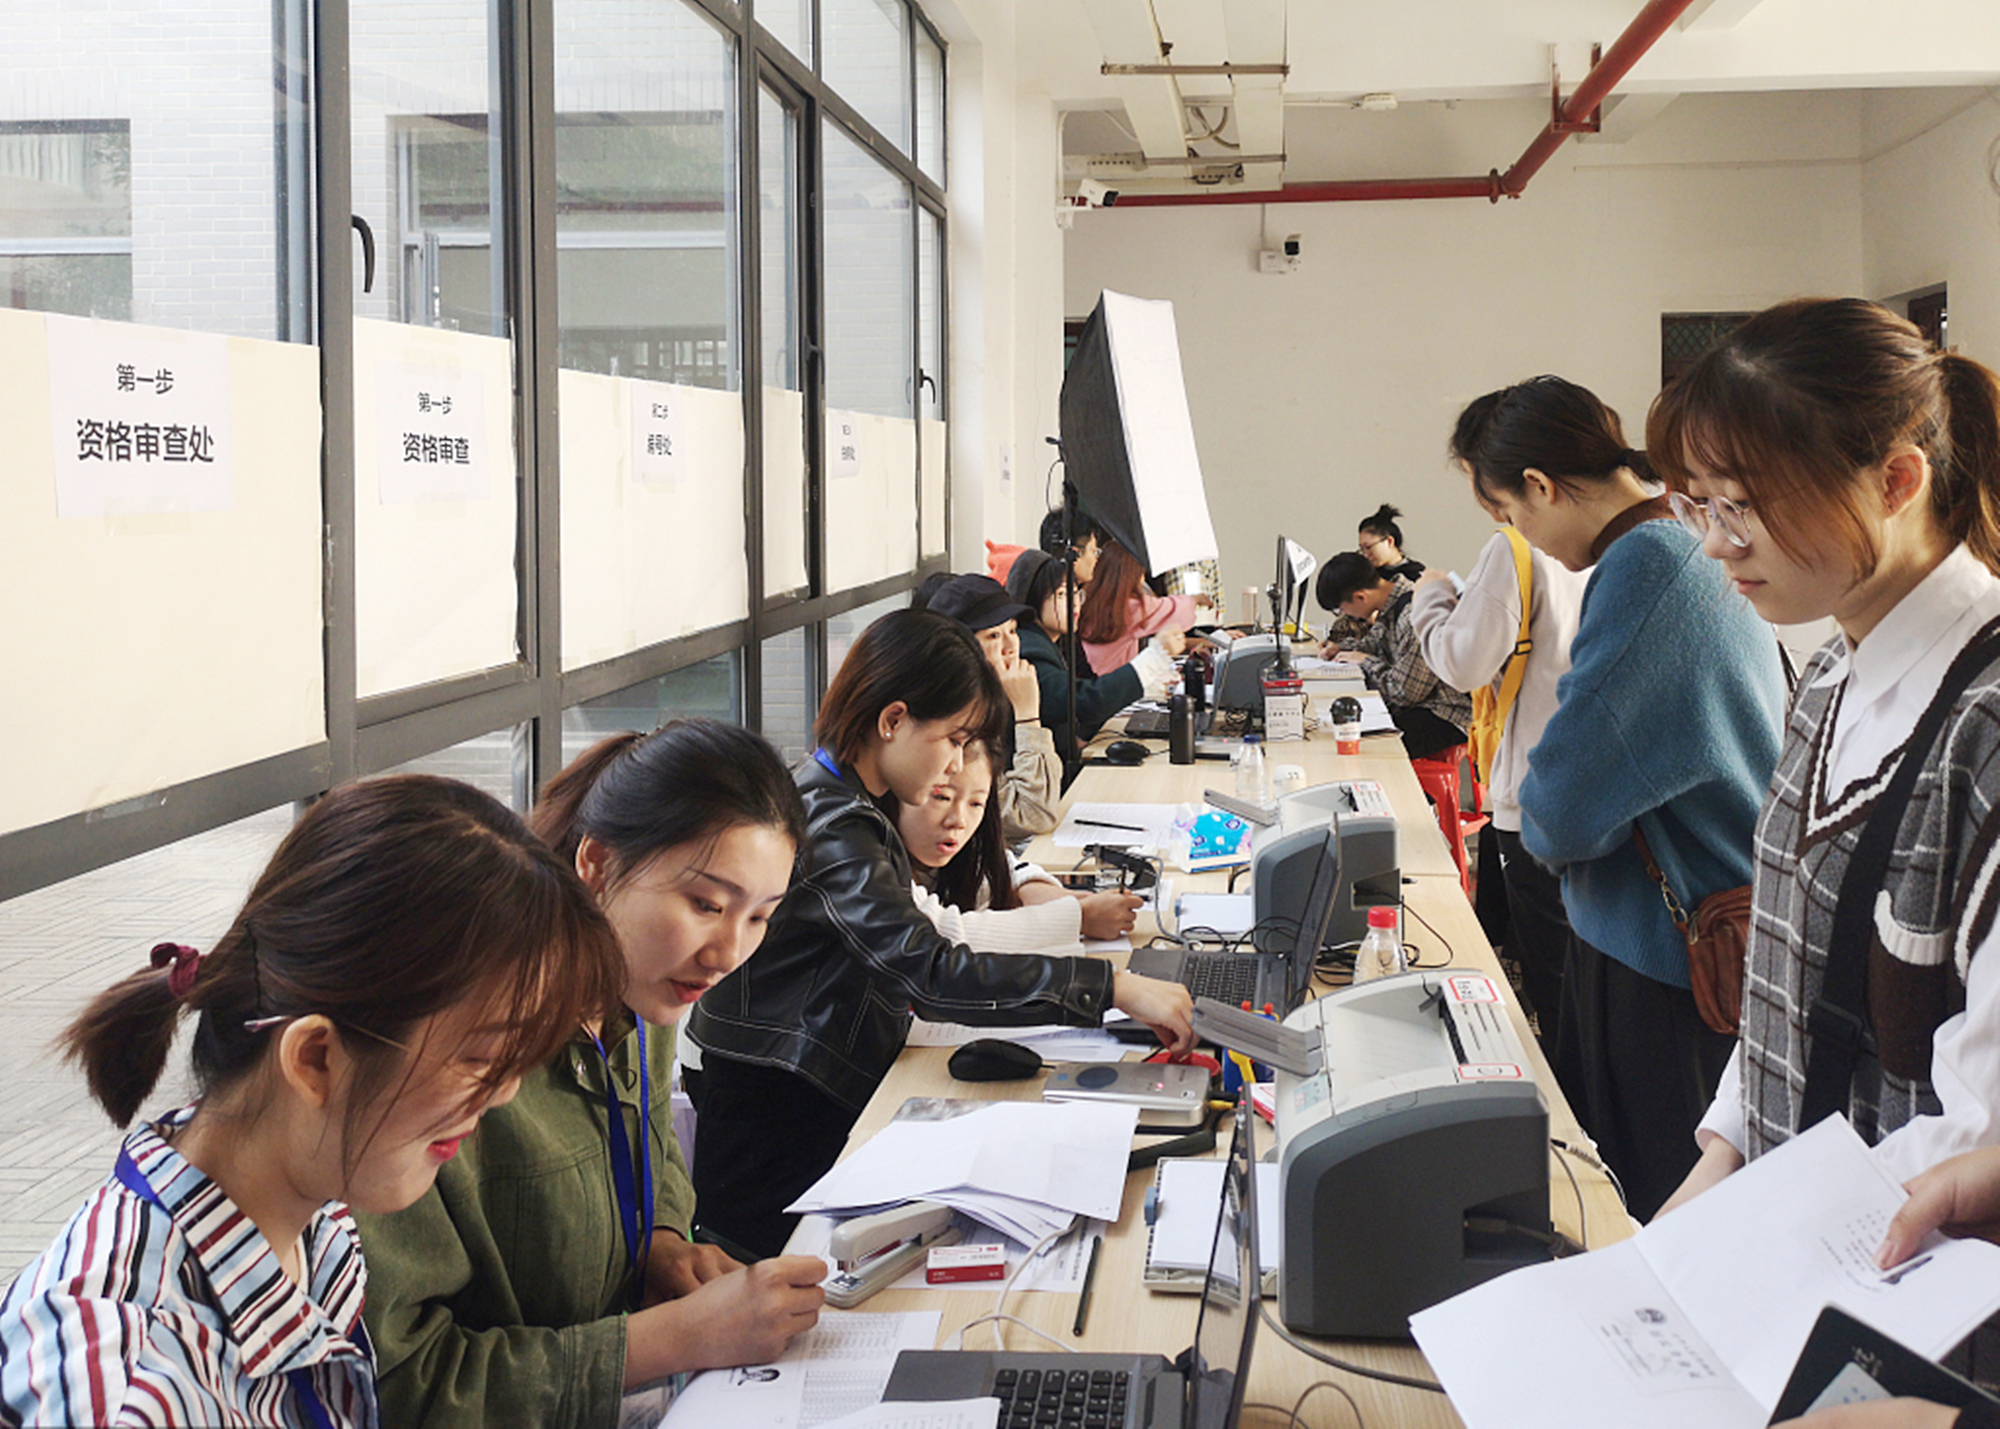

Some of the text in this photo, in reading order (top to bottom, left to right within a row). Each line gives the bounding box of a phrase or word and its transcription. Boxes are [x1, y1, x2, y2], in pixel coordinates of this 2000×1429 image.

[116, 362, 174, 394] 第一步
[417, 391, 452, 415] 第一步
[76, 417, 214, 463] 资格审查处
[402, 431, 470, 464] 资格审查
